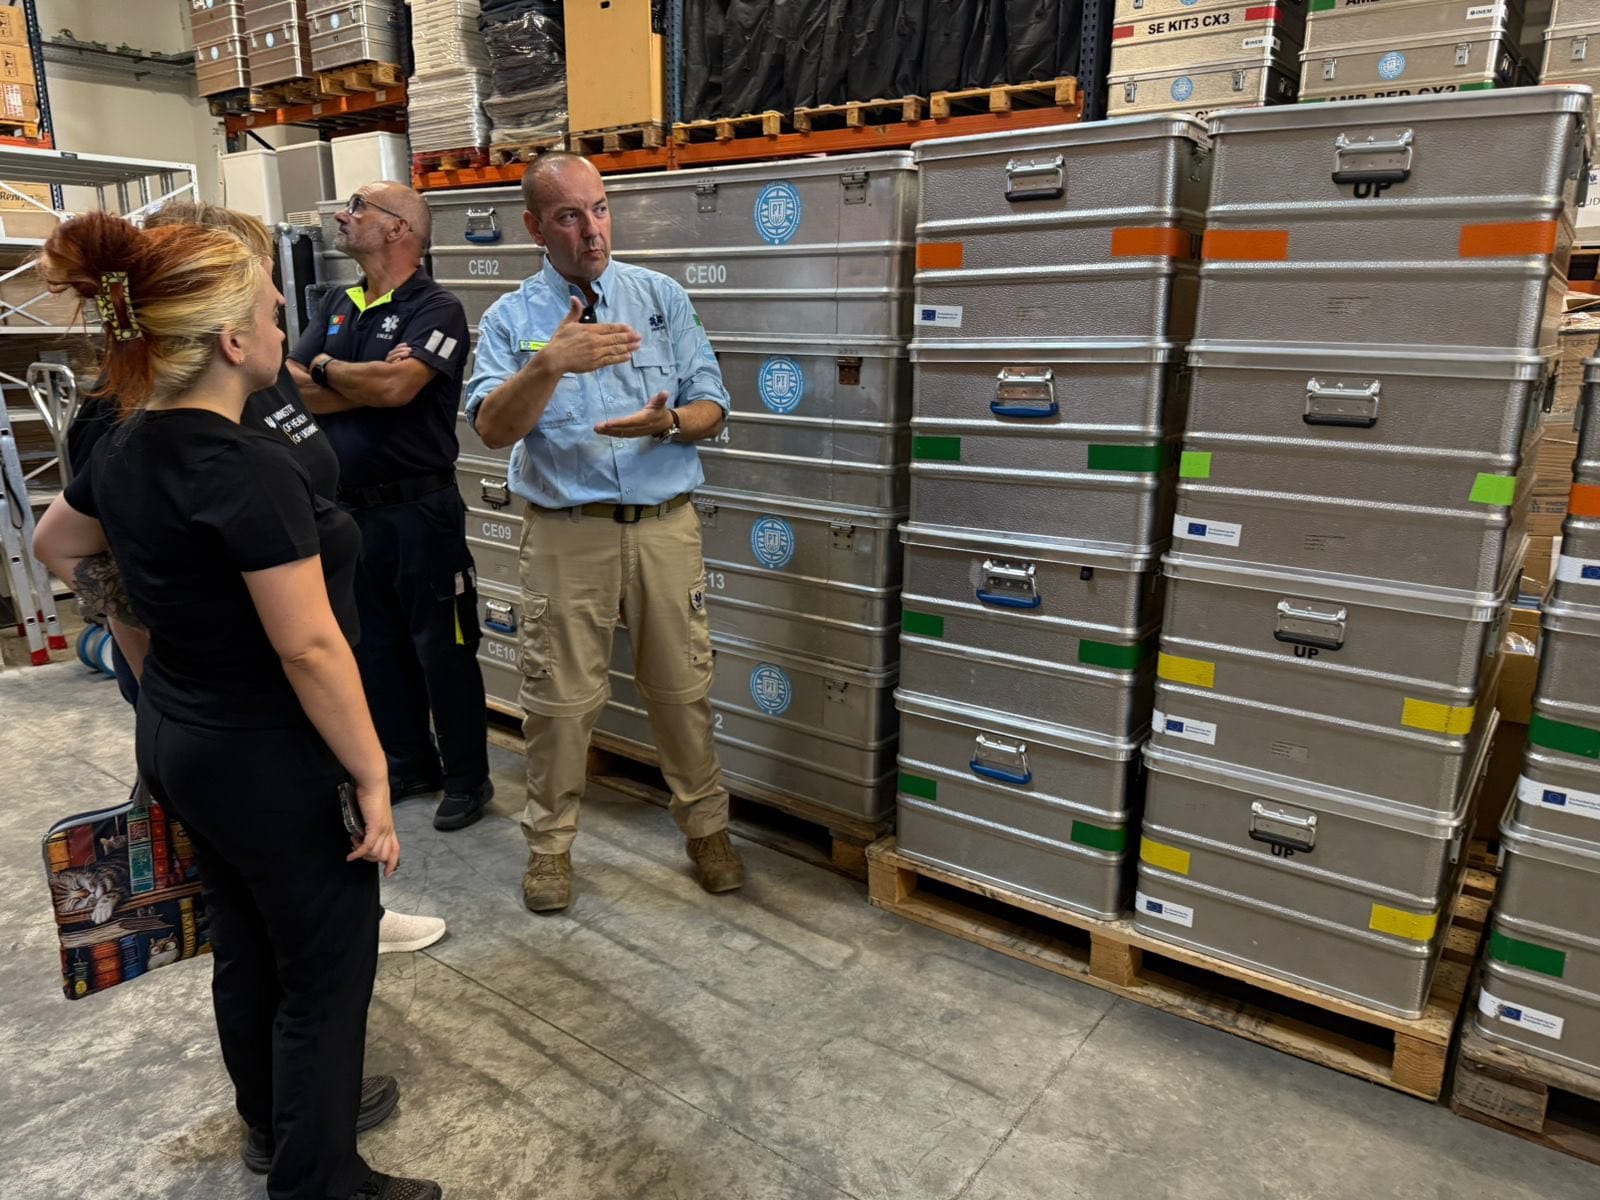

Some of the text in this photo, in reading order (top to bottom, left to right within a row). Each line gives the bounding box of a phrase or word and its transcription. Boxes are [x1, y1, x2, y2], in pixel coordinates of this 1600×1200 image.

[1148, 13, 1230, 35] SE KIT3 CX3
[468, 259, 500, 276] CE02
[685, 264, 727, 284] CE00
[482, 522, 512, 540] CE09
[704, 571, 725, 590] 13
[487, 641, 516, 661] CE10
[1294, 645, 1319, 659] UP
[1271, 843, 1295, 858] UP
